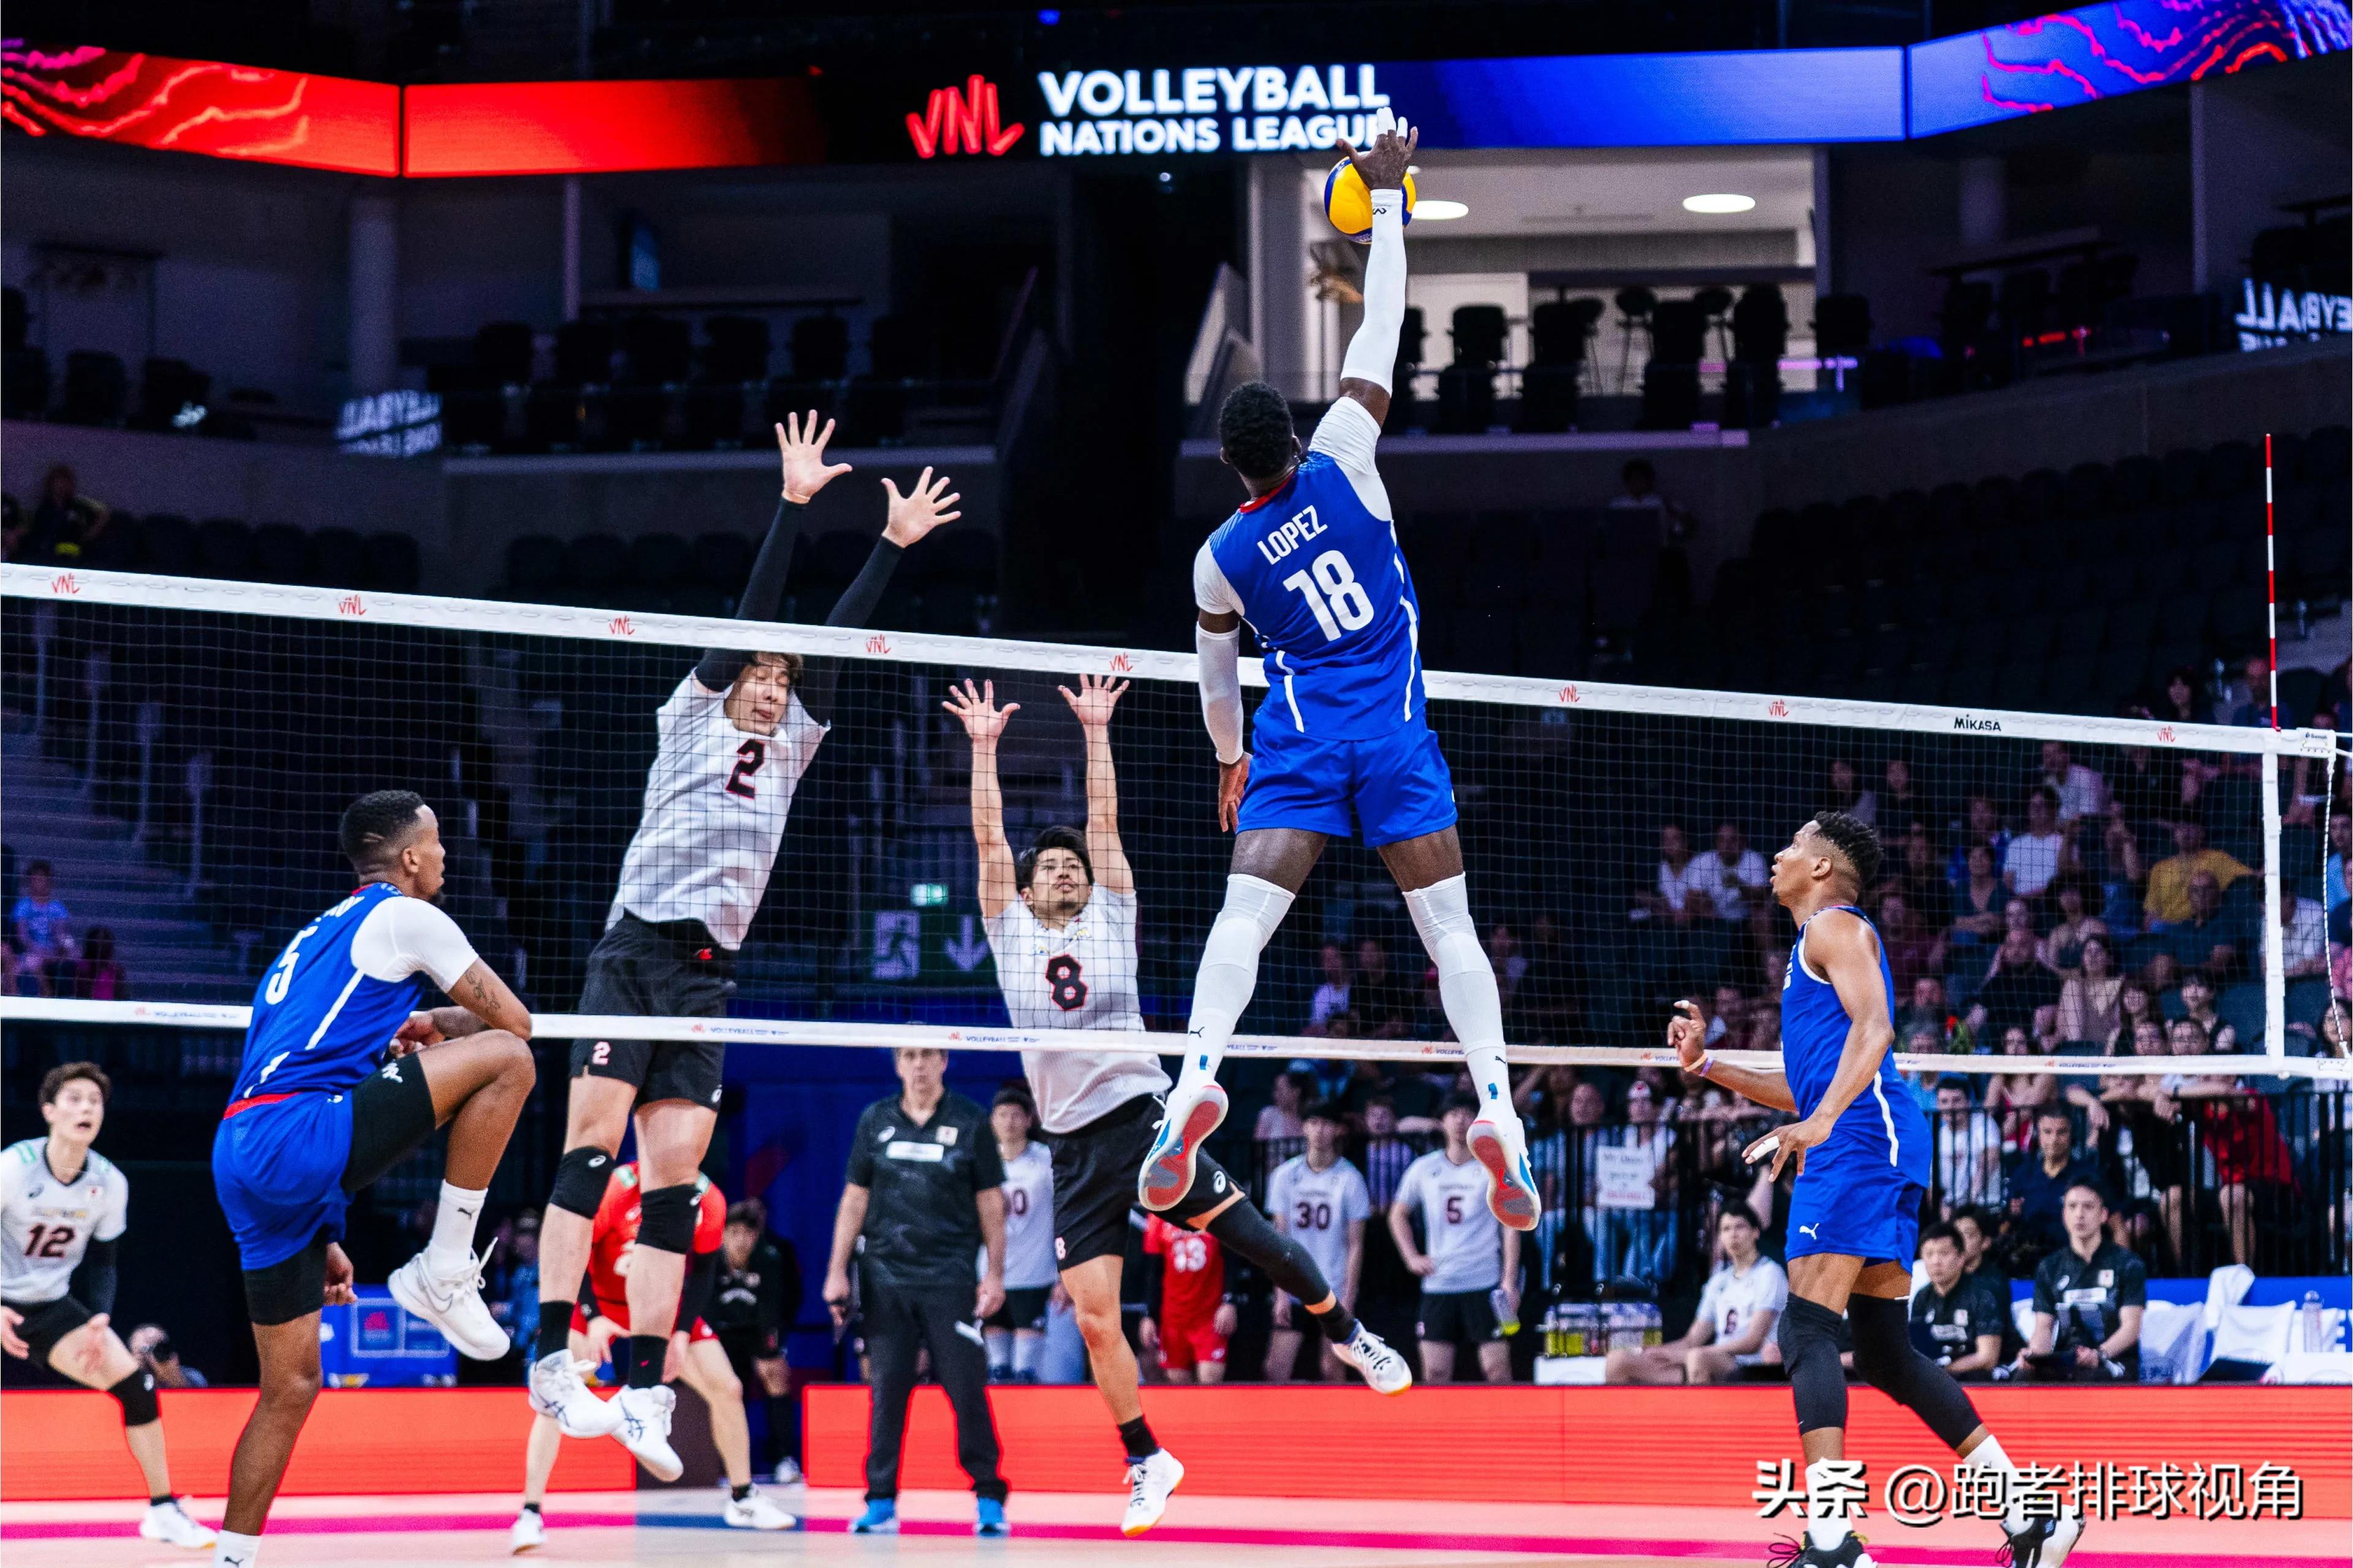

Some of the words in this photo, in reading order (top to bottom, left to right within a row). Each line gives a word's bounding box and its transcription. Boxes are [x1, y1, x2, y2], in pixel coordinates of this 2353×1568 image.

[906, 74, 1025, 159] VNL
[1038, 63, 1390, 117] VOLLEYBALL
[1040, 118, 1221, 157] NATIONS
[1257, 504, 1328, 566] LOPEZ
[1283, 550, 1374, 642] 18
[1952, 714, 2003, 732] MIKASA
[725, 738, 765, 799] 2
[265, 925, 319, 1005] 5
[1045, 953, 1088, 1012] 8
[592, 1040, 610, 1065] 2
[24, 1222, 75, 1259] 12
[1296, 1201, 1332, 1231] 30
[1054, 1237, 1066, 1260] 8
